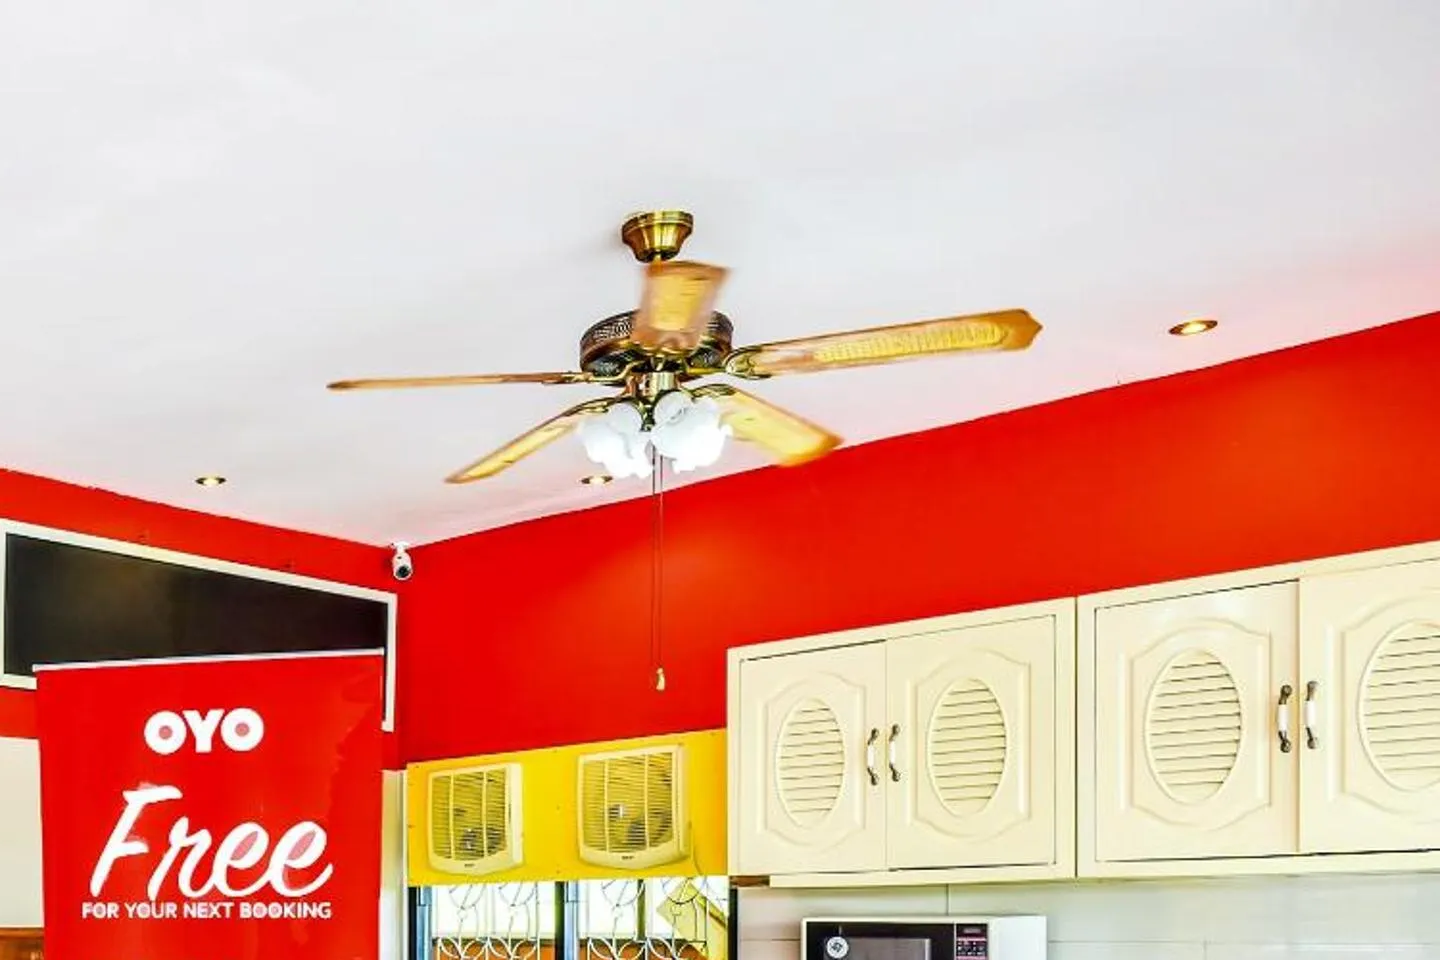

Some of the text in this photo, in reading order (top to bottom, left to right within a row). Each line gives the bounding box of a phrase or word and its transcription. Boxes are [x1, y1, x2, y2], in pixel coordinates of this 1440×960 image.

[143, 707, 265, 755] OYO
[89, 783, 334, 901] Free
[81, 901, 333, 919] FOR YOUR NEXT BOOKING
